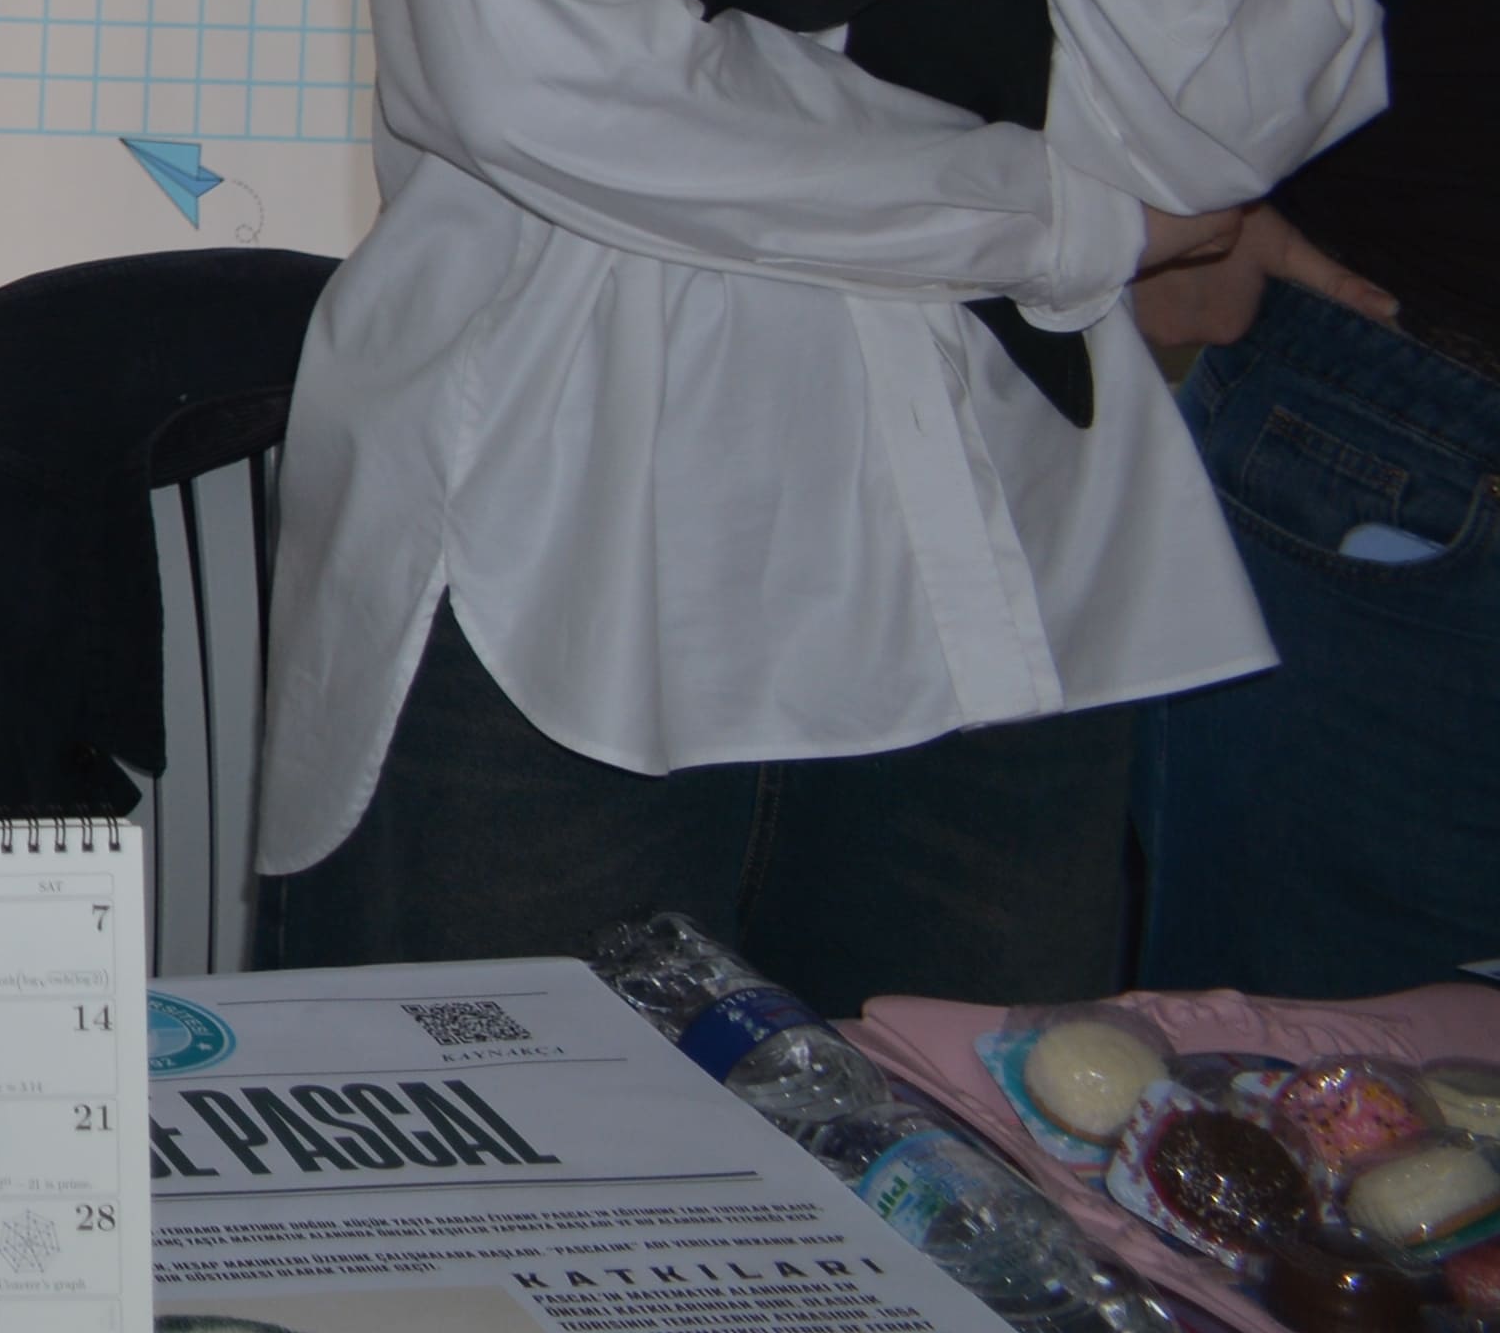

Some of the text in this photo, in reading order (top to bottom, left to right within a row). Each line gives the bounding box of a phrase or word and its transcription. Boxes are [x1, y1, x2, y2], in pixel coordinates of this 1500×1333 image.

[38, 880, 63, 892] SAT
[91, 905, 110, 931] 7
[73, 1003, 113, 1031] 14
[73, 1104, 113, 1132] 21
[178, 1080, 563, 1175] PASCAL
[74, 1203, 117, 1232] 28
[510, 1256, 886, 1289] KATKILARI
